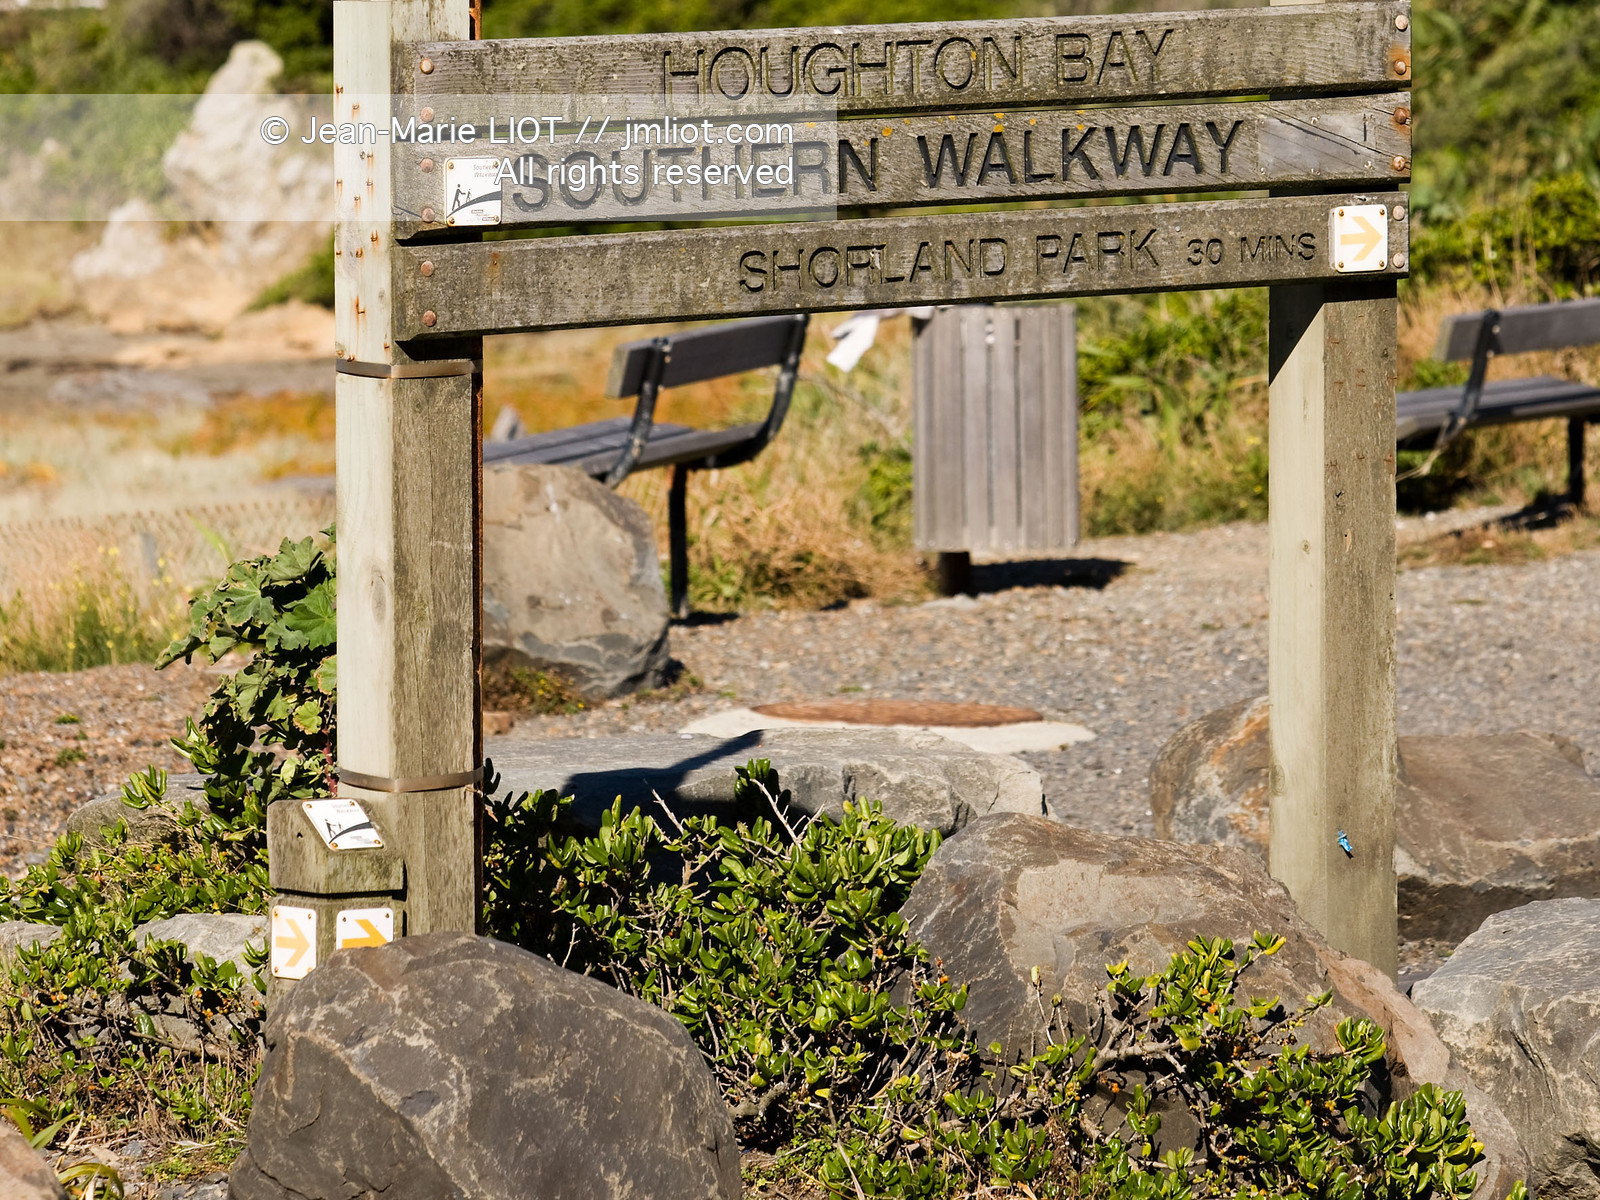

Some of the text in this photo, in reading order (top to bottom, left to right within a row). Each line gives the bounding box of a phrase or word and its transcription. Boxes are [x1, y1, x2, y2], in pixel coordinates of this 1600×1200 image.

[664, 29, 1175, 105] HOUGHTON BAY
[512, 120, 1244, 212] SOUTHERN WALKWAY
[1036, 229, 1160, 276] PARK
[1187, 238, 1223, 266] 30
[1240, 232, 1317, 264] MINS
